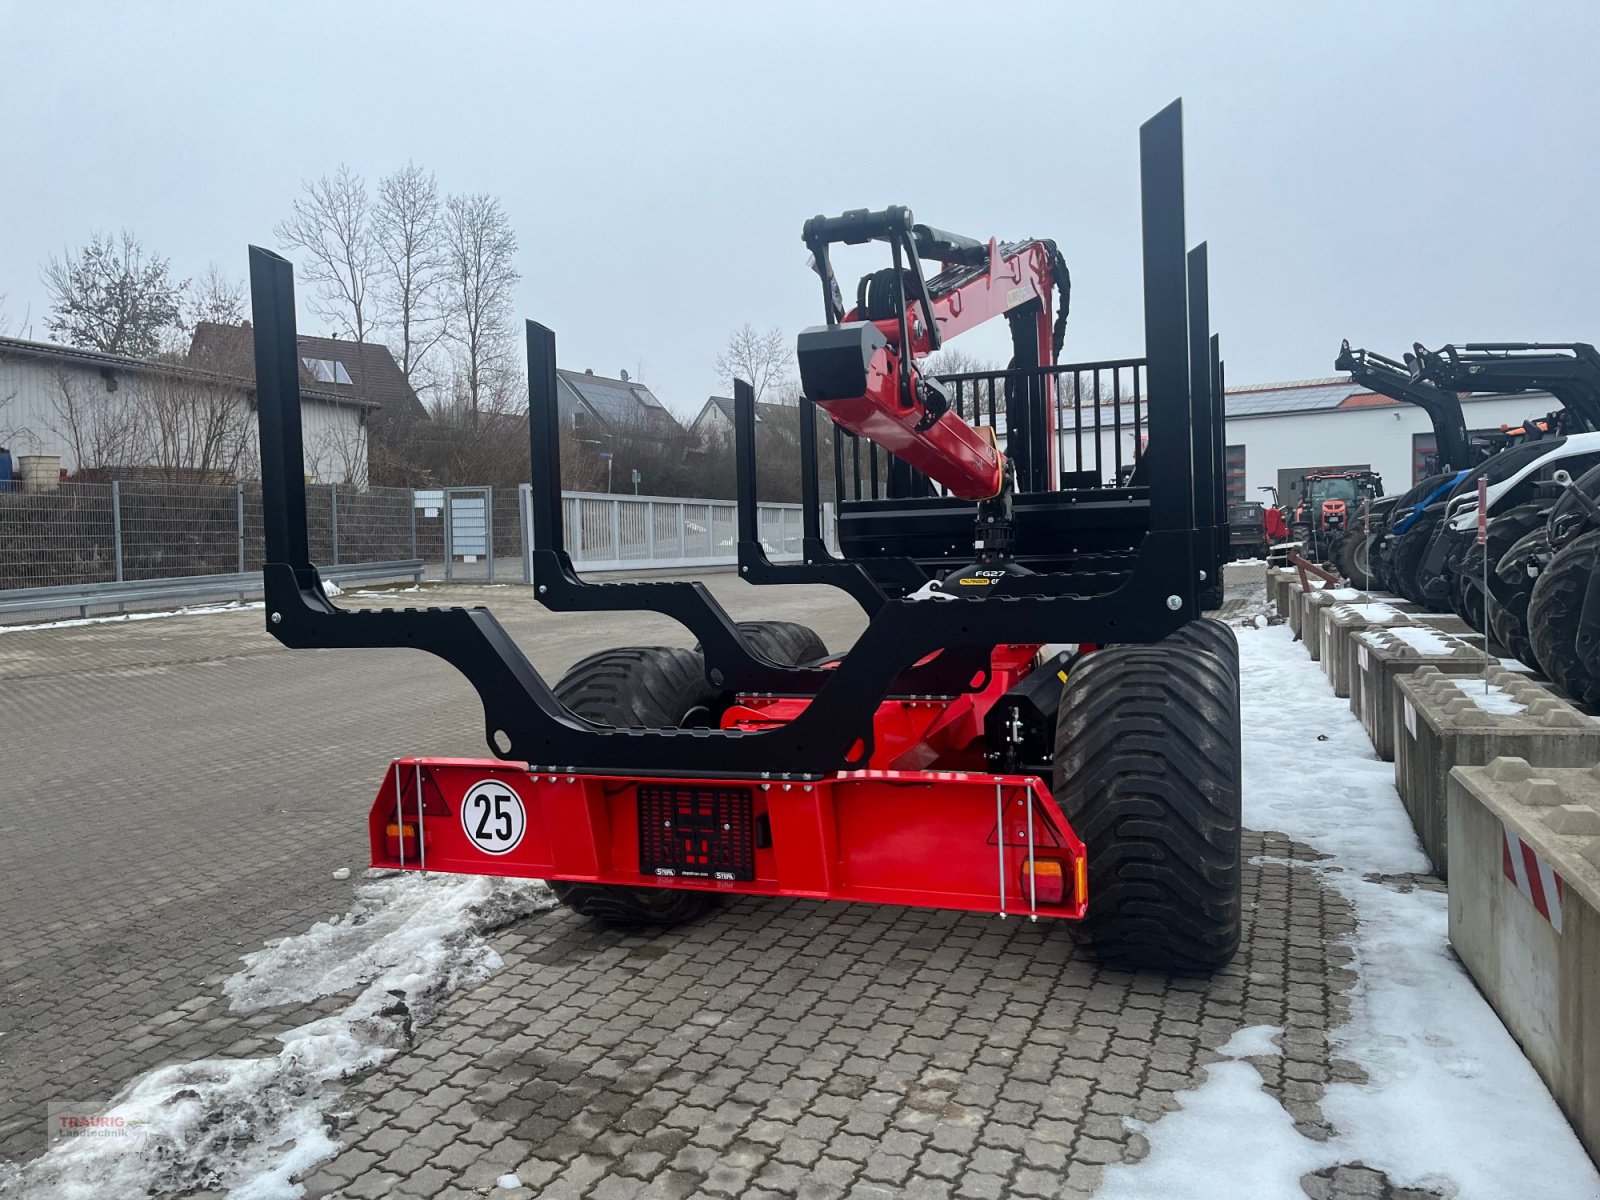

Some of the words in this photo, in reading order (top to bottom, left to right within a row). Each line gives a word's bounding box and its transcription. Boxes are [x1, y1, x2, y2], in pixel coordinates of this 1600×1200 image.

[474, 794, 513, 841] 25
[655, 868, 674, 876] STEPA
[715, 872, 735, 880] STEPA
